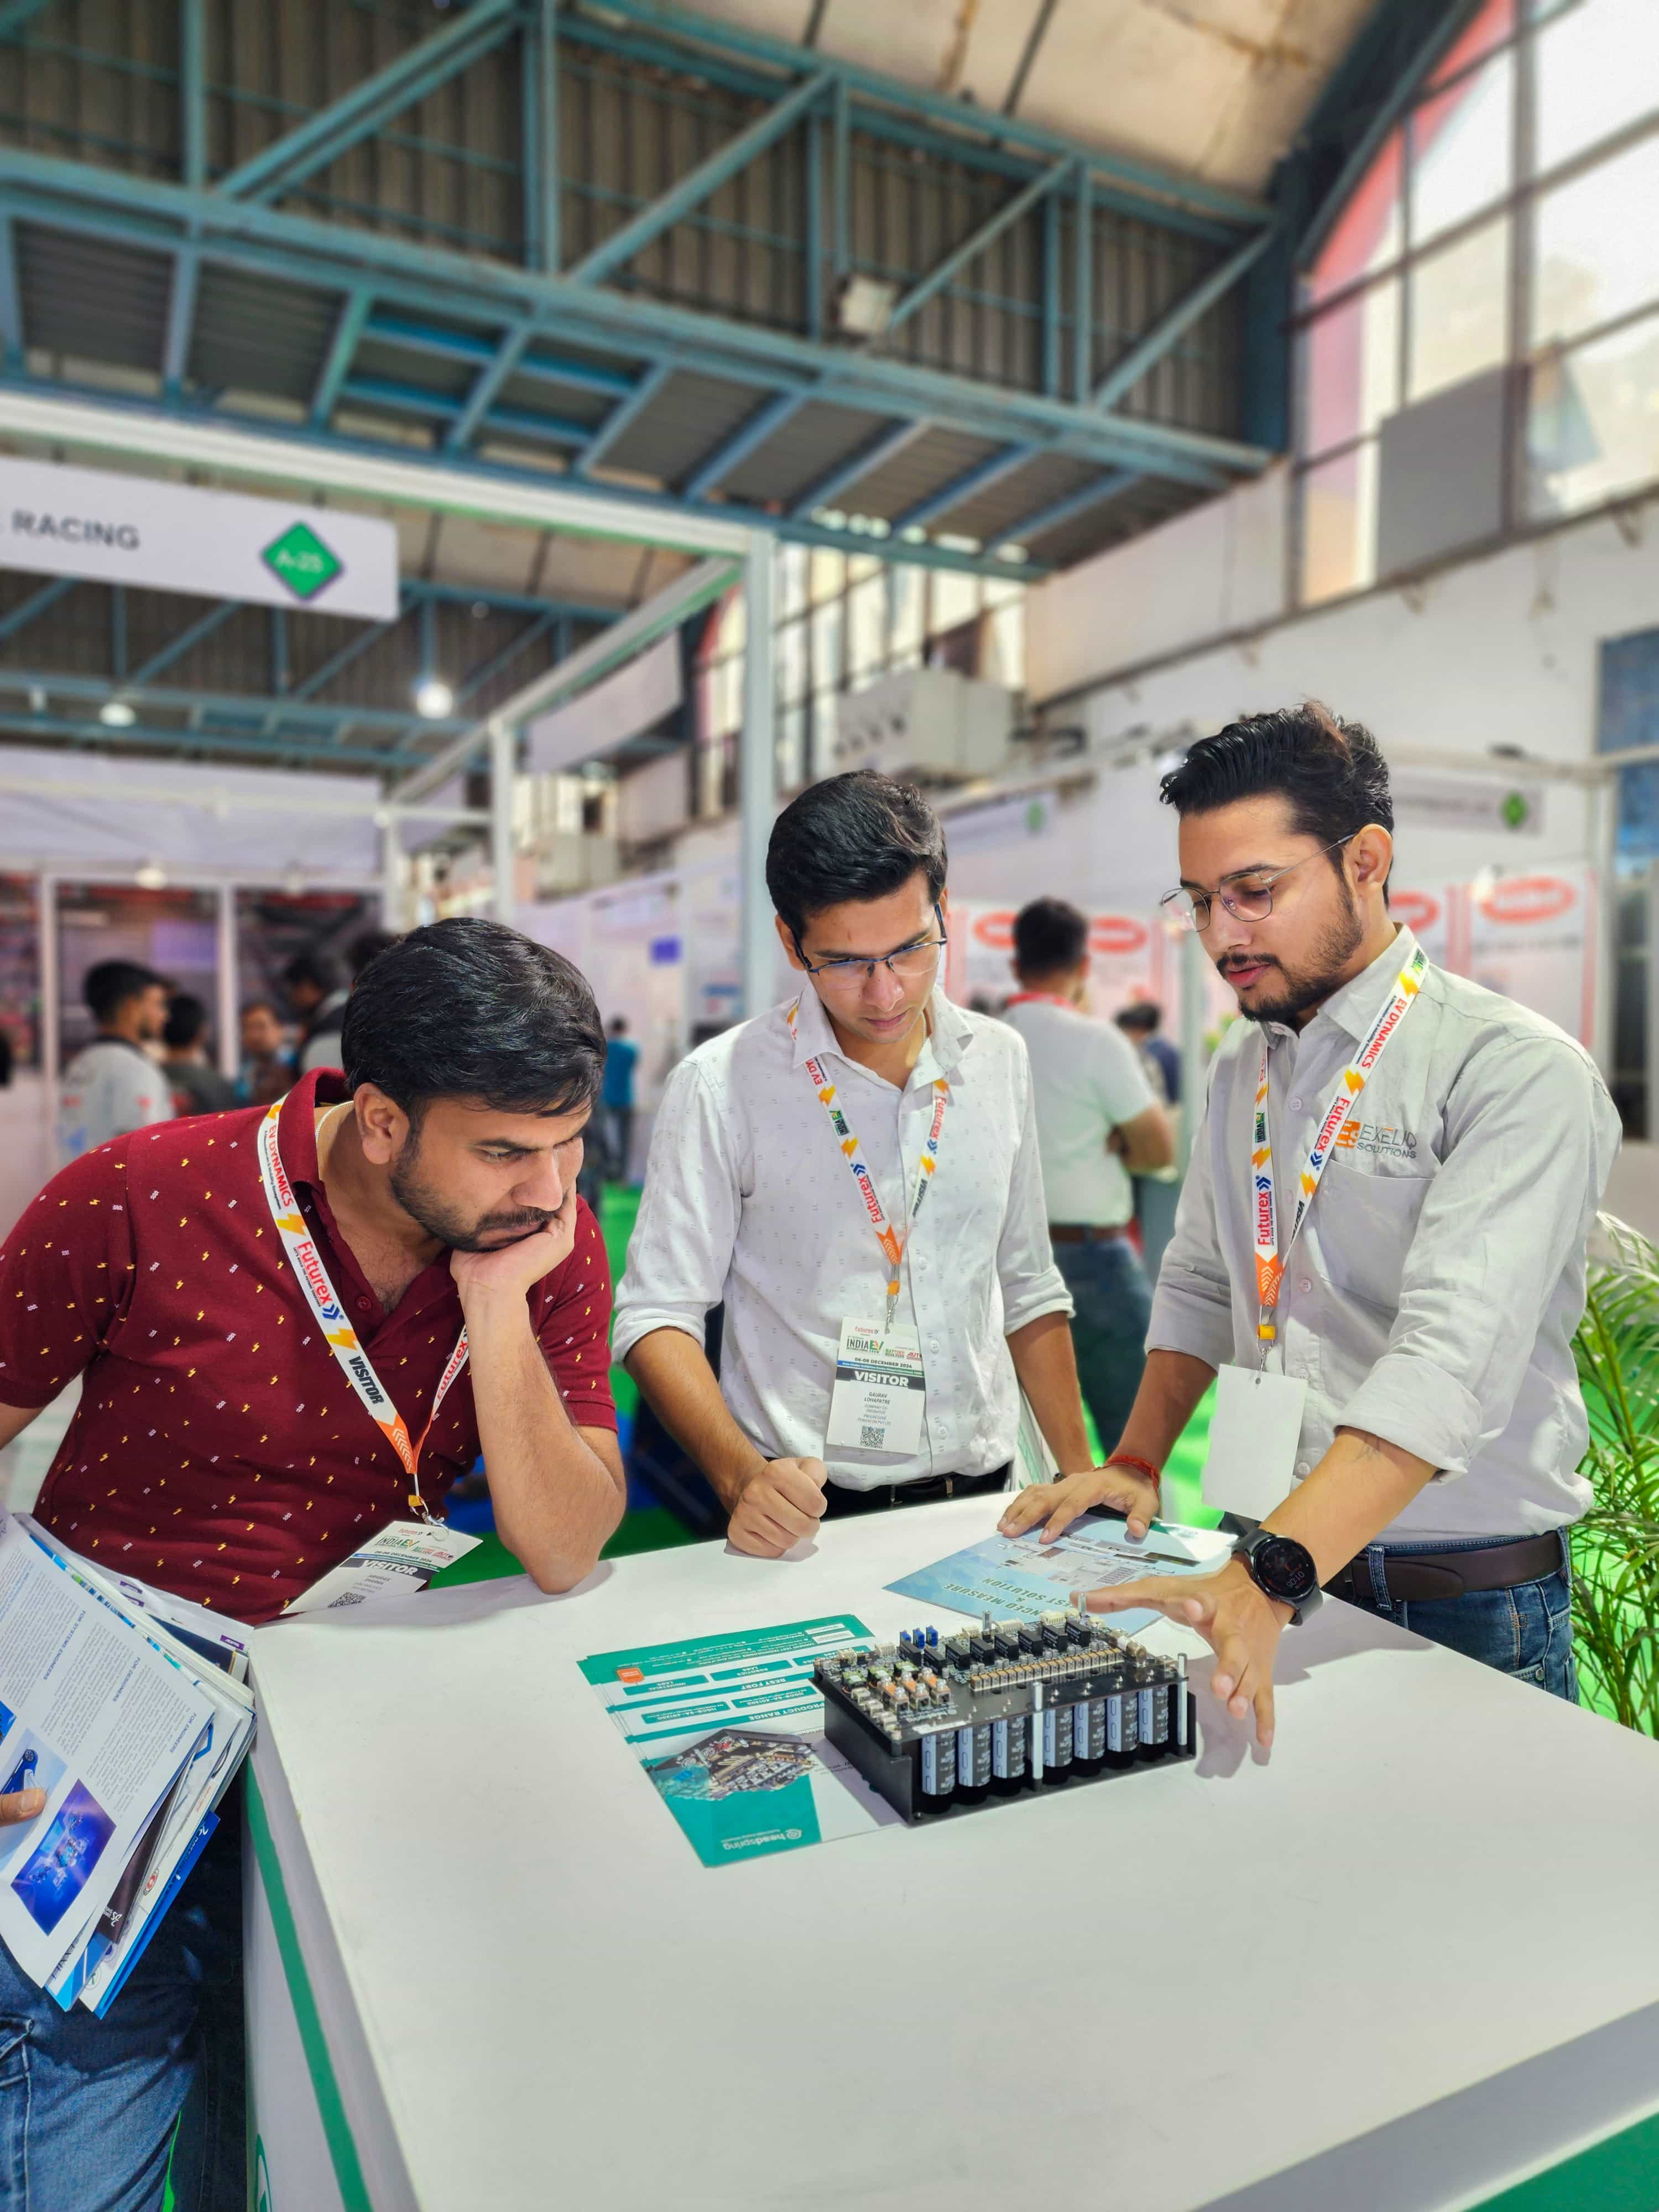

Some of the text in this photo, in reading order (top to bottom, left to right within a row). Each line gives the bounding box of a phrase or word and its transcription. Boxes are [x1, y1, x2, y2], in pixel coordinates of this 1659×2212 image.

[12, 510, 140, 551] RACING
[1360, 998, 1407, 1070] EV DYNAMICS
[811, 1072, 823, 1086] EV
[1320, 1097, 1350, 1154] Futurex
[1357, 1141, 1418, 1160] SOLUTIONS
[265, 1123, 295, 1208] EV DYNAMICS
[858, 1176, 882, 1224] Futurex
[1255, 1192, 1271, 1245] Futurex
[298, 1239, 333, 1305] Futurex
[847, 1338, 884, 1351] INDIA EV
[348, 1354, 386, 1407] VISITOR
[434, 1340, 468, 1399] Futurex
[854, 1371, 909, 1386] VISITOR
[362, 1559, 419, 1575] VISITOR
[943, 1580, 1005, 1608] MEASURE
[982, 1575, 1046, 1602] SOLUTION
[42, 1609, 86, 1681] FOR SYSTEMS ENGINEERS
[131, 1656, 140, 1669] FOR
[187, 1712, 197, 1724] FOR
[748, 1702, 824, 1720] PRODUCT RANGE
[721, 1832, 786, 1852] headspring
